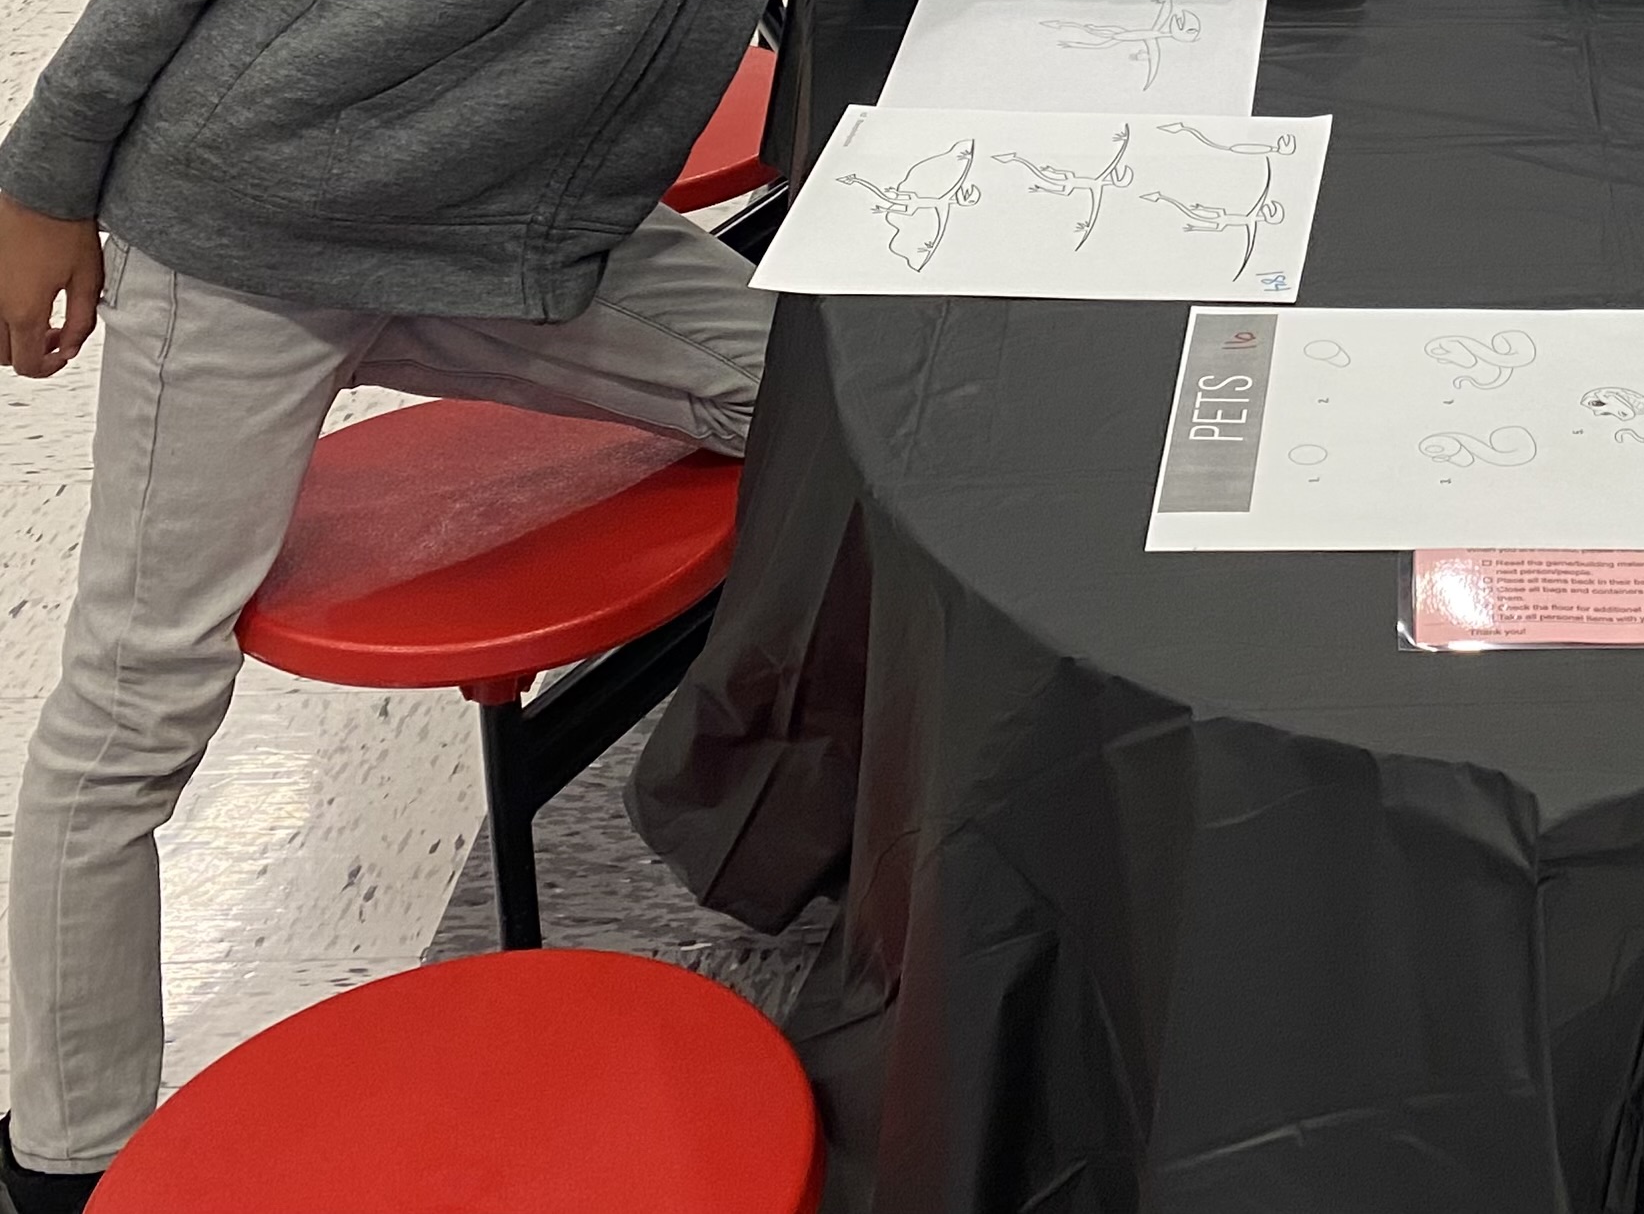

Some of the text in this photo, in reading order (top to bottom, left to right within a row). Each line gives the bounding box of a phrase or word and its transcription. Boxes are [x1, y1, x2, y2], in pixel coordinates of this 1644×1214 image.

[1189, 332, 1256, 441] PETS 16
[1591, 587, 1644, 595] containers
[1540, 614, 1584, 623] personal
[1504, 628, 1526, 636] you!
